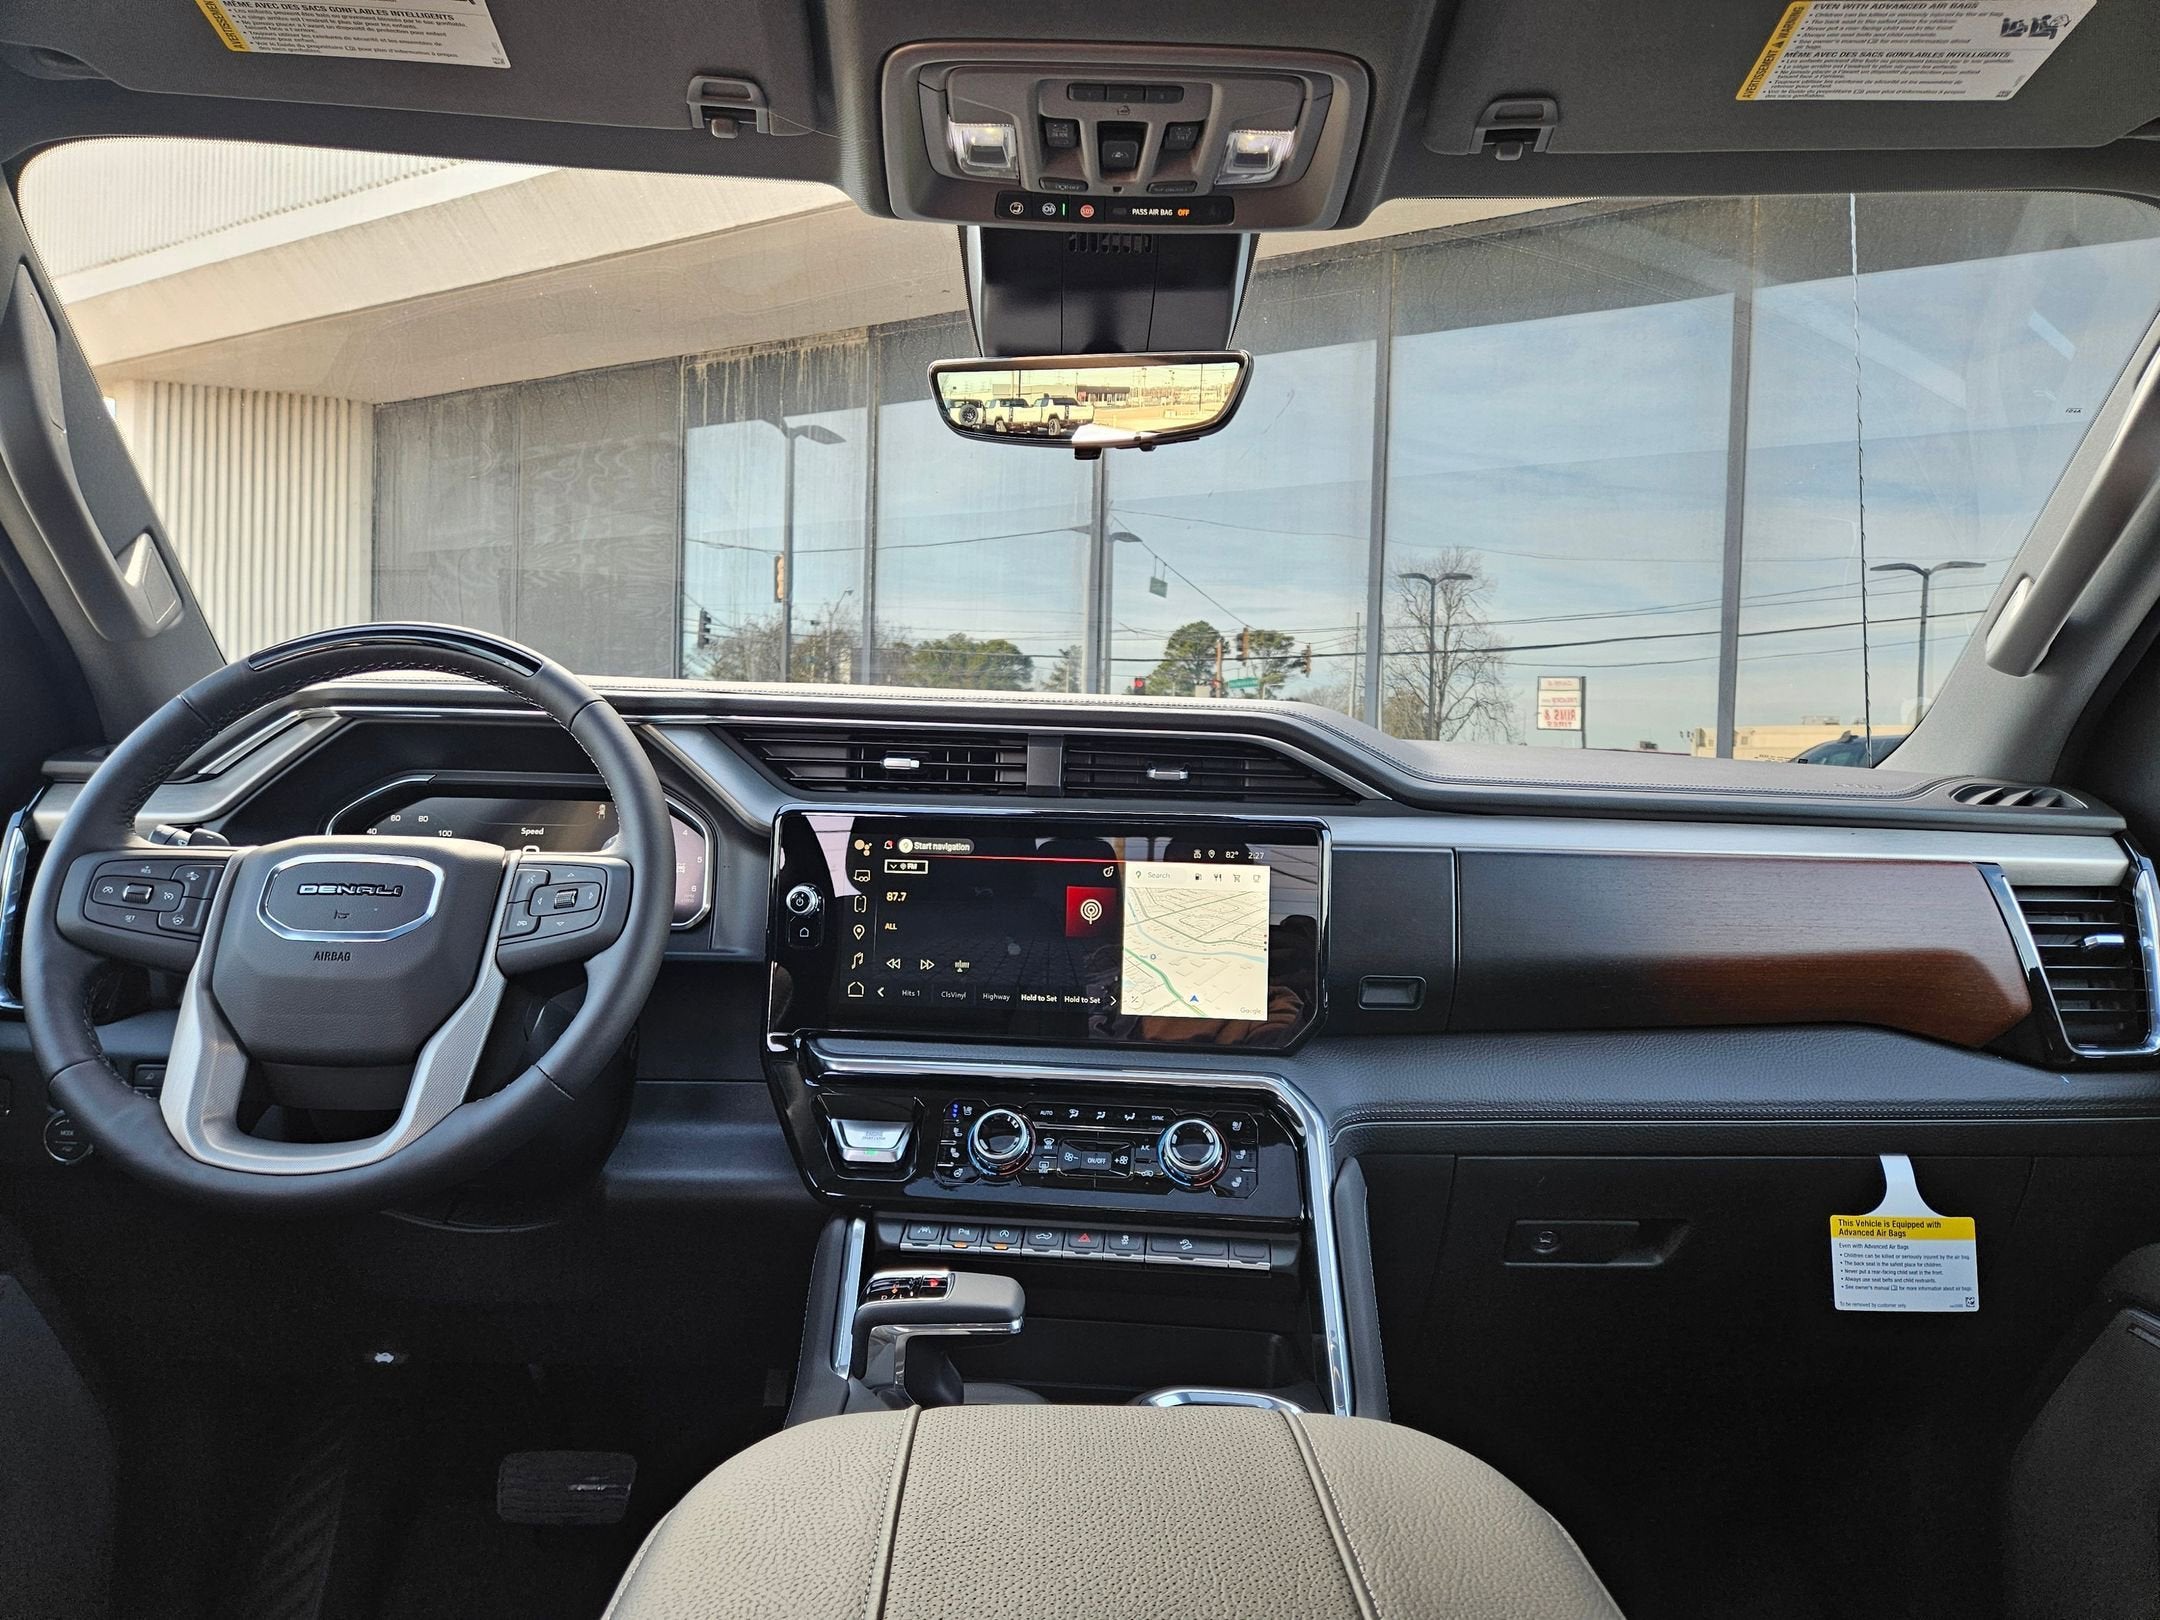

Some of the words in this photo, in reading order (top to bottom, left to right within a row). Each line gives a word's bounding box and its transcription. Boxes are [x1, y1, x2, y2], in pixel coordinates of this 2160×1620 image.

[223, 0, 253, 8] MÊME
[328, 6, 388, 16] GONFLABLES
[390, 10, 455, 20] INTELLIGENTS
[1777, 6, 1804, 40] WARNING
[1742, 50, 1778, 98] AVERTISSEMENT
[521, 827, 544, 836] Speed
[914, 842, 932, 850] Start
[933, 843, 970, 852] navigation
[298, 884, 404, 897] DENALI
[886, 892, 907, 901] 87.7
[313, 951, 351, 961] AIRBAG
[941, 991, 967, 1000] ClsVinyl
[982, 993, 1010, 1001] Highway
[1838, 1219, 1853, 1227] This
[1884, 1220, 1890, 1228] is
[1892, 1221, 1924, 1229] Equipped
[1889, 1230, 1906, 1238] Bags
